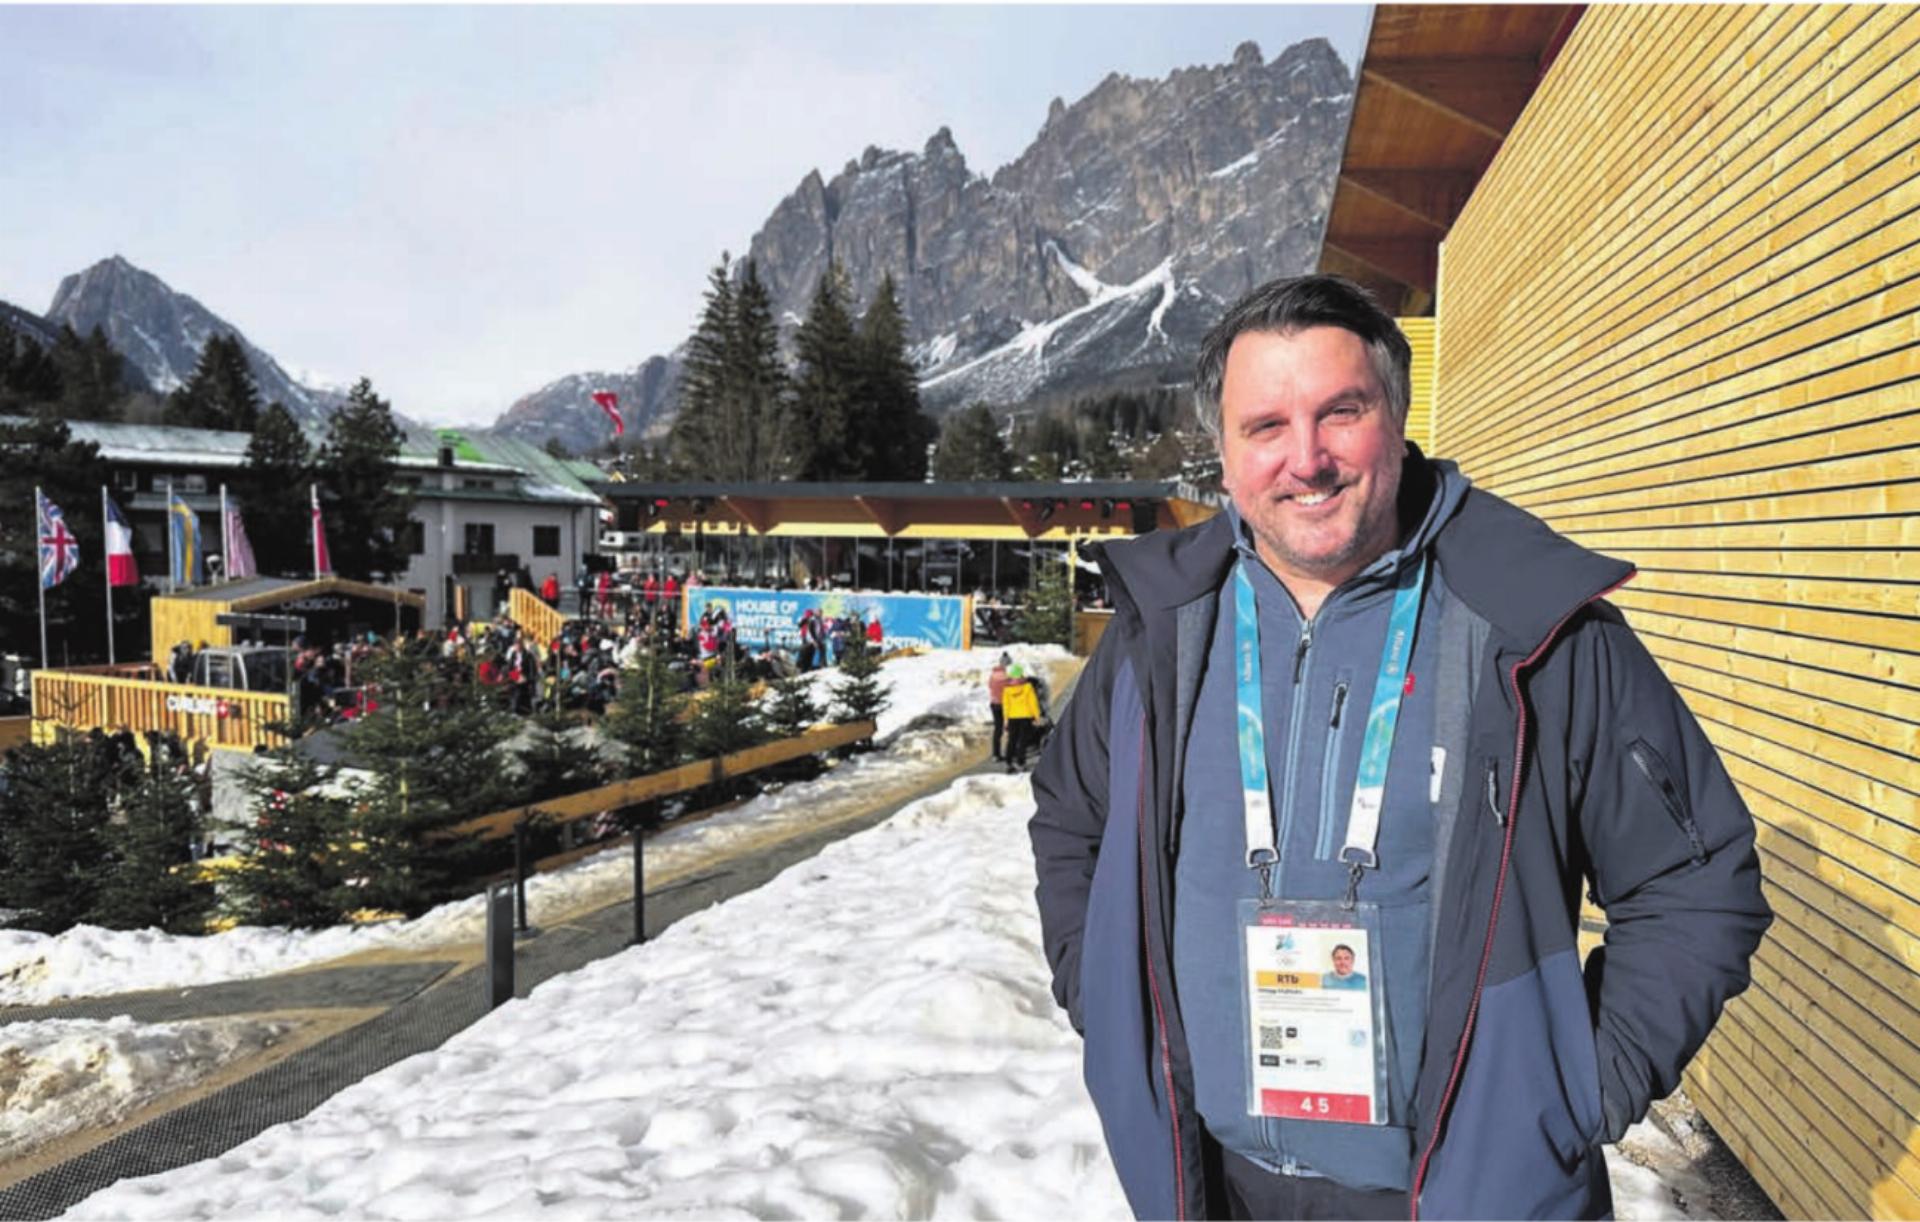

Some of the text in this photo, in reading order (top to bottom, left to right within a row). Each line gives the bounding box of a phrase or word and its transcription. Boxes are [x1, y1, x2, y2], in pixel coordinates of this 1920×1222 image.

[735, 599, 798, 615] HOUSE OF
[882, 636, 933, 651] ORTINA
[1300, 1097, 1329, 1113] 4 5
